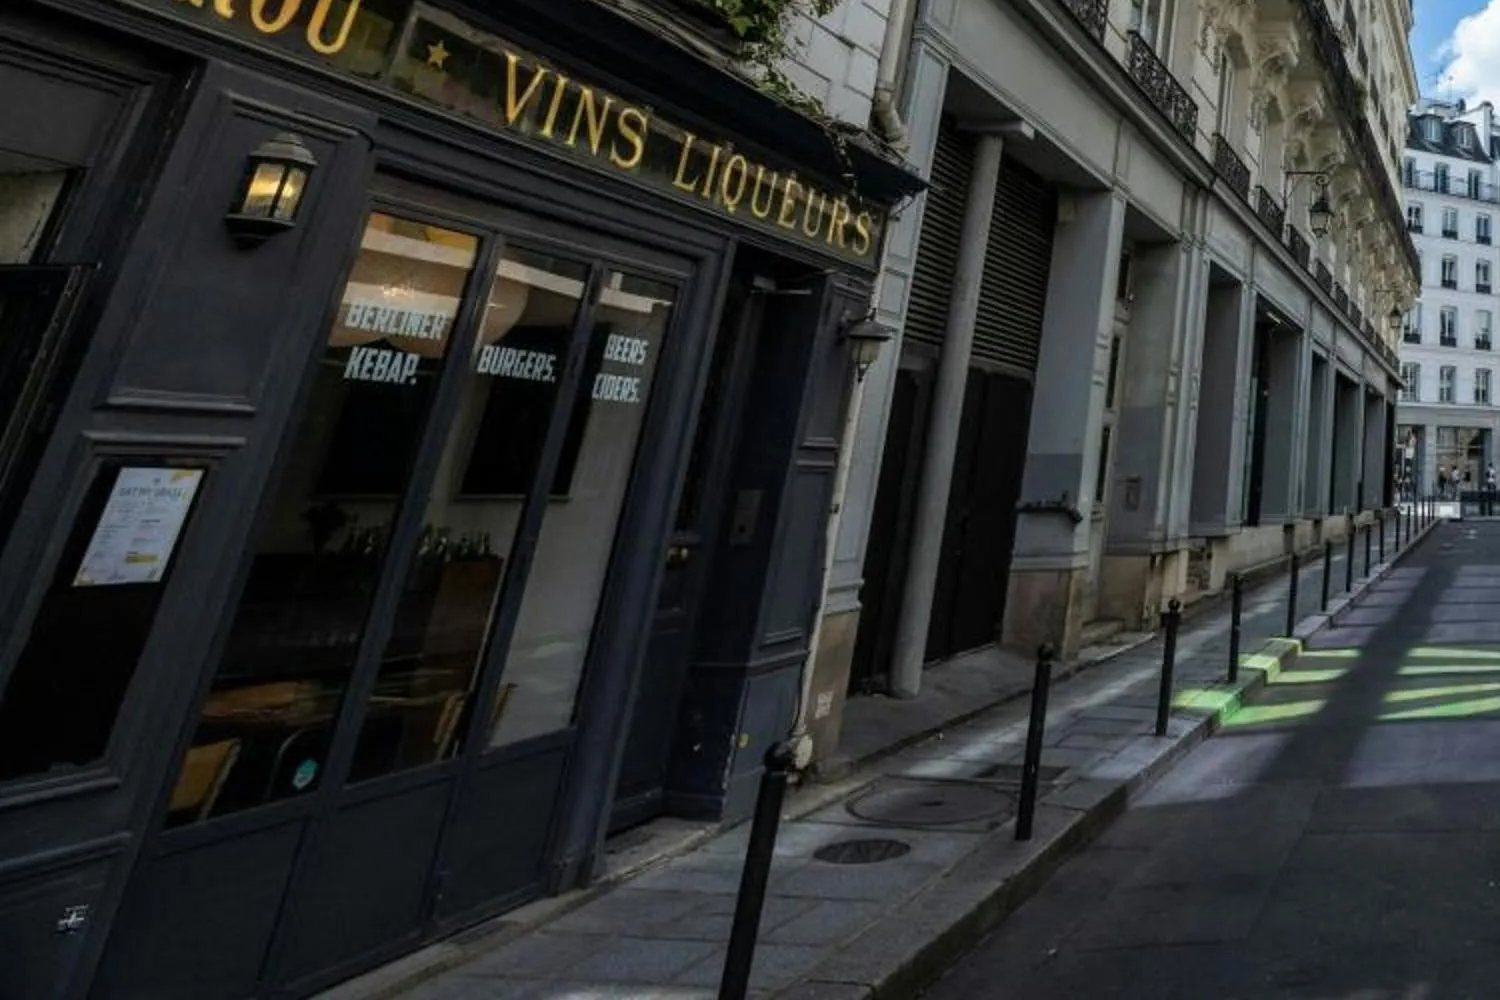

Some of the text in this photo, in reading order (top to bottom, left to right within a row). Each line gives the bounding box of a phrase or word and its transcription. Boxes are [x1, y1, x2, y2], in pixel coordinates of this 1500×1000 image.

[504, 50, 649, 168] VINS
[671, 131, 873, 257] LIQUEURS
[345, 304, 447, 340] BERLINER
[477, 344, 557, 383] BURGERS.
[603, 334, 649, 365] BEERS
